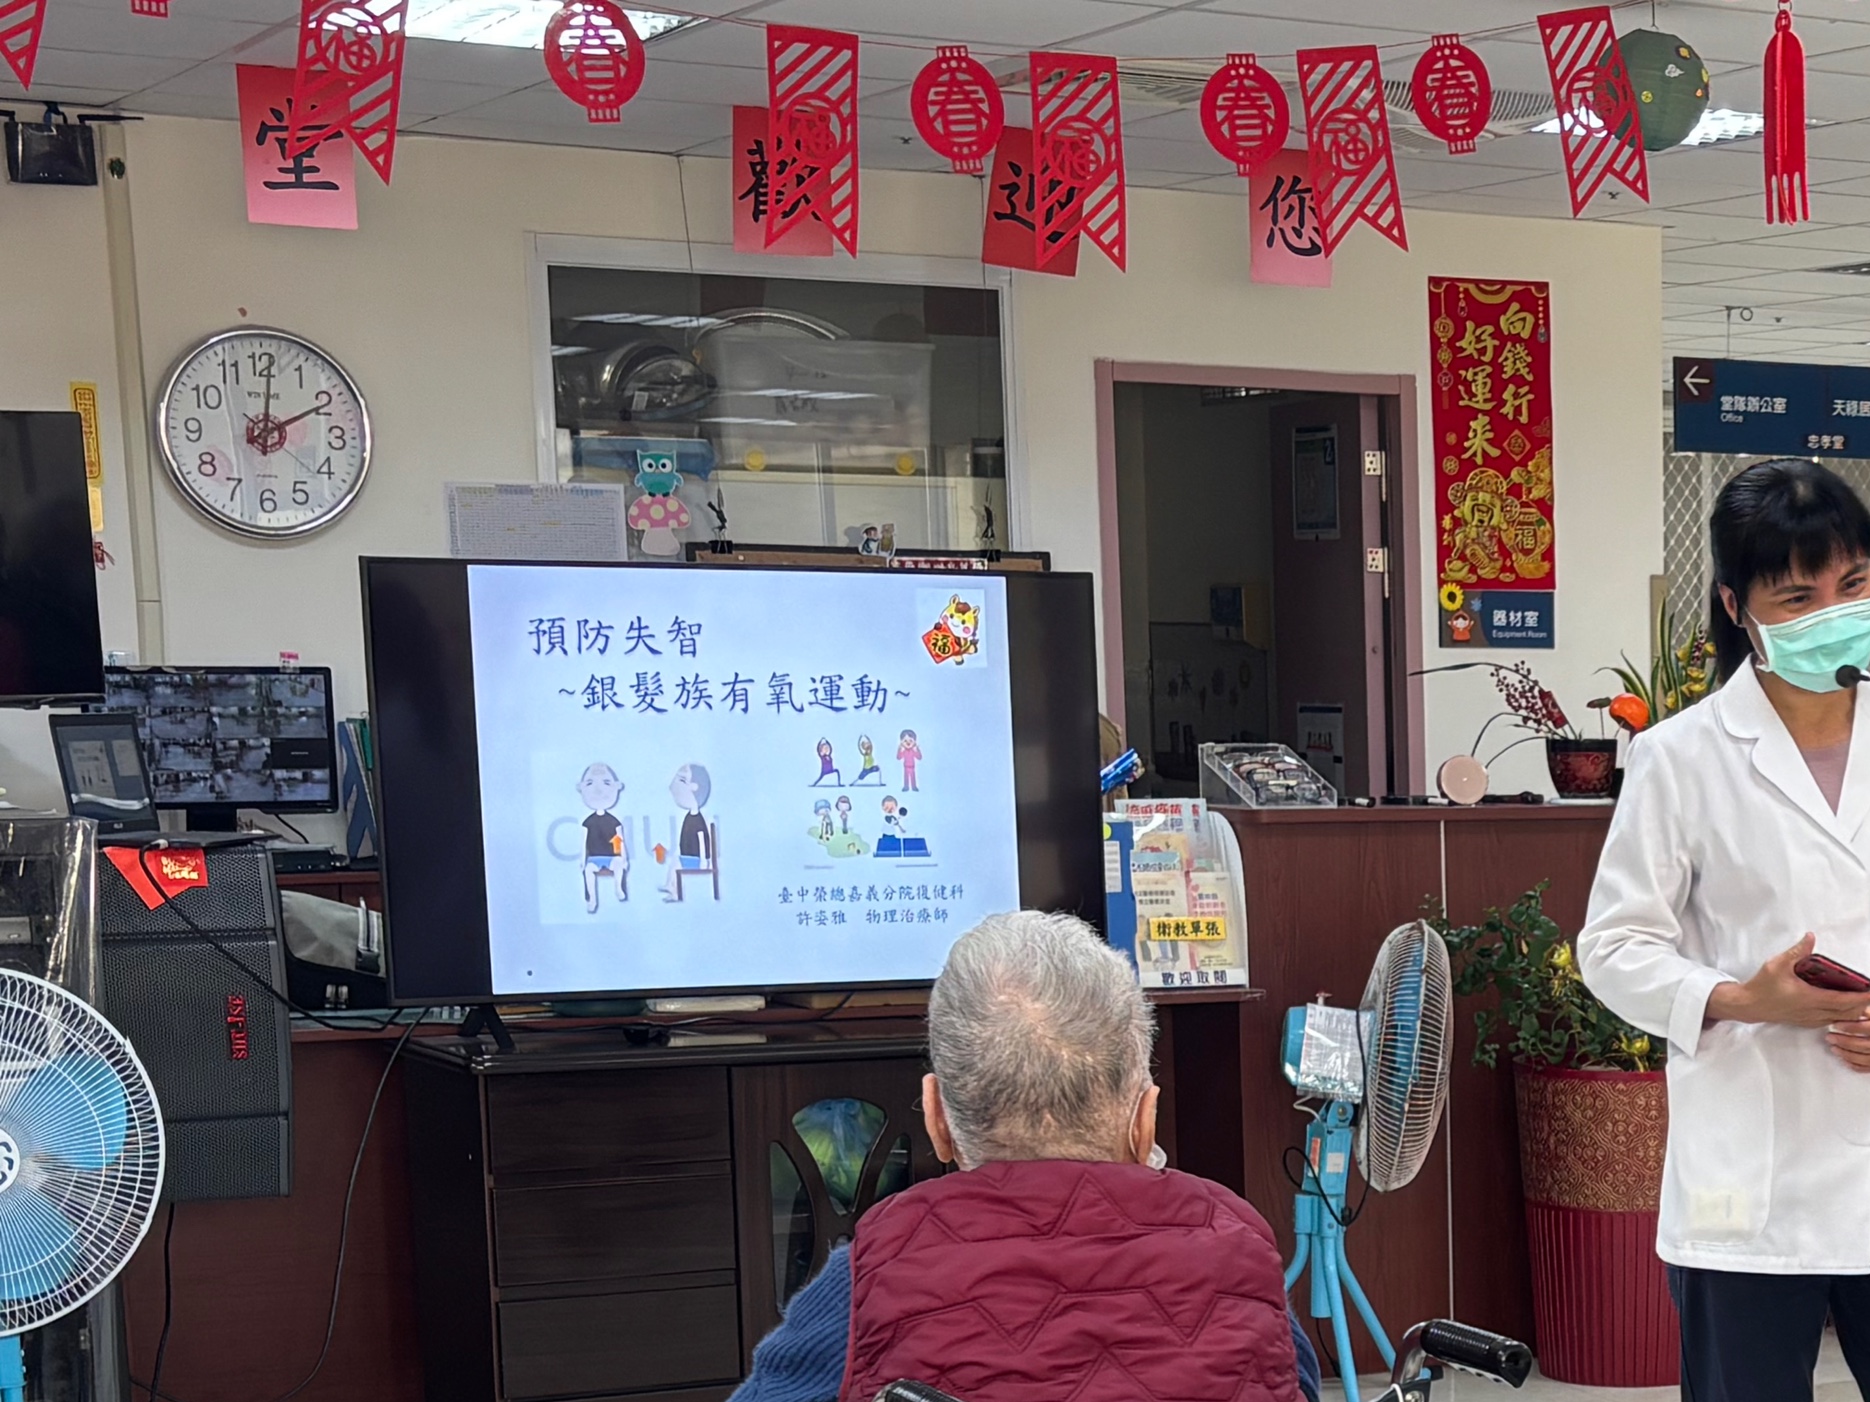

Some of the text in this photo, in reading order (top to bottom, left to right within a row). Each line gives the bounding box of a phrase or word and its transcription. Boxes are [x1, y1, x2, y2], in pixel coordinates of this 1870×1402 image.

[256, 97, 344, 190] 堂
[1259, 176, 1324, 256] 您
[218, 359, 239, 385] 11
[248, 352, 275, 378] 12
[1498, 302, 1535, 424] 向錢行
[294, 364, 303, 389] 1
[191, 384, 222, 409] 10
[315, 391, 332, 416] 2
[184, 417, 202, 442] 9
[328, 425, 346, 450] 3
[198, 452, 216, 477] 8
[317, 456, 335, 480] 4
[226, 477, 242, 501] 7
[260, 489, 277, 513] 6
[292, 481, 309, 505] 5
[1492, 609, 1539, 627] 器材室
[528, 614, 703, 659] 預防失智
[929, 629, 953, 657] 福
[866, 907, 949, 924] 物理治療師
